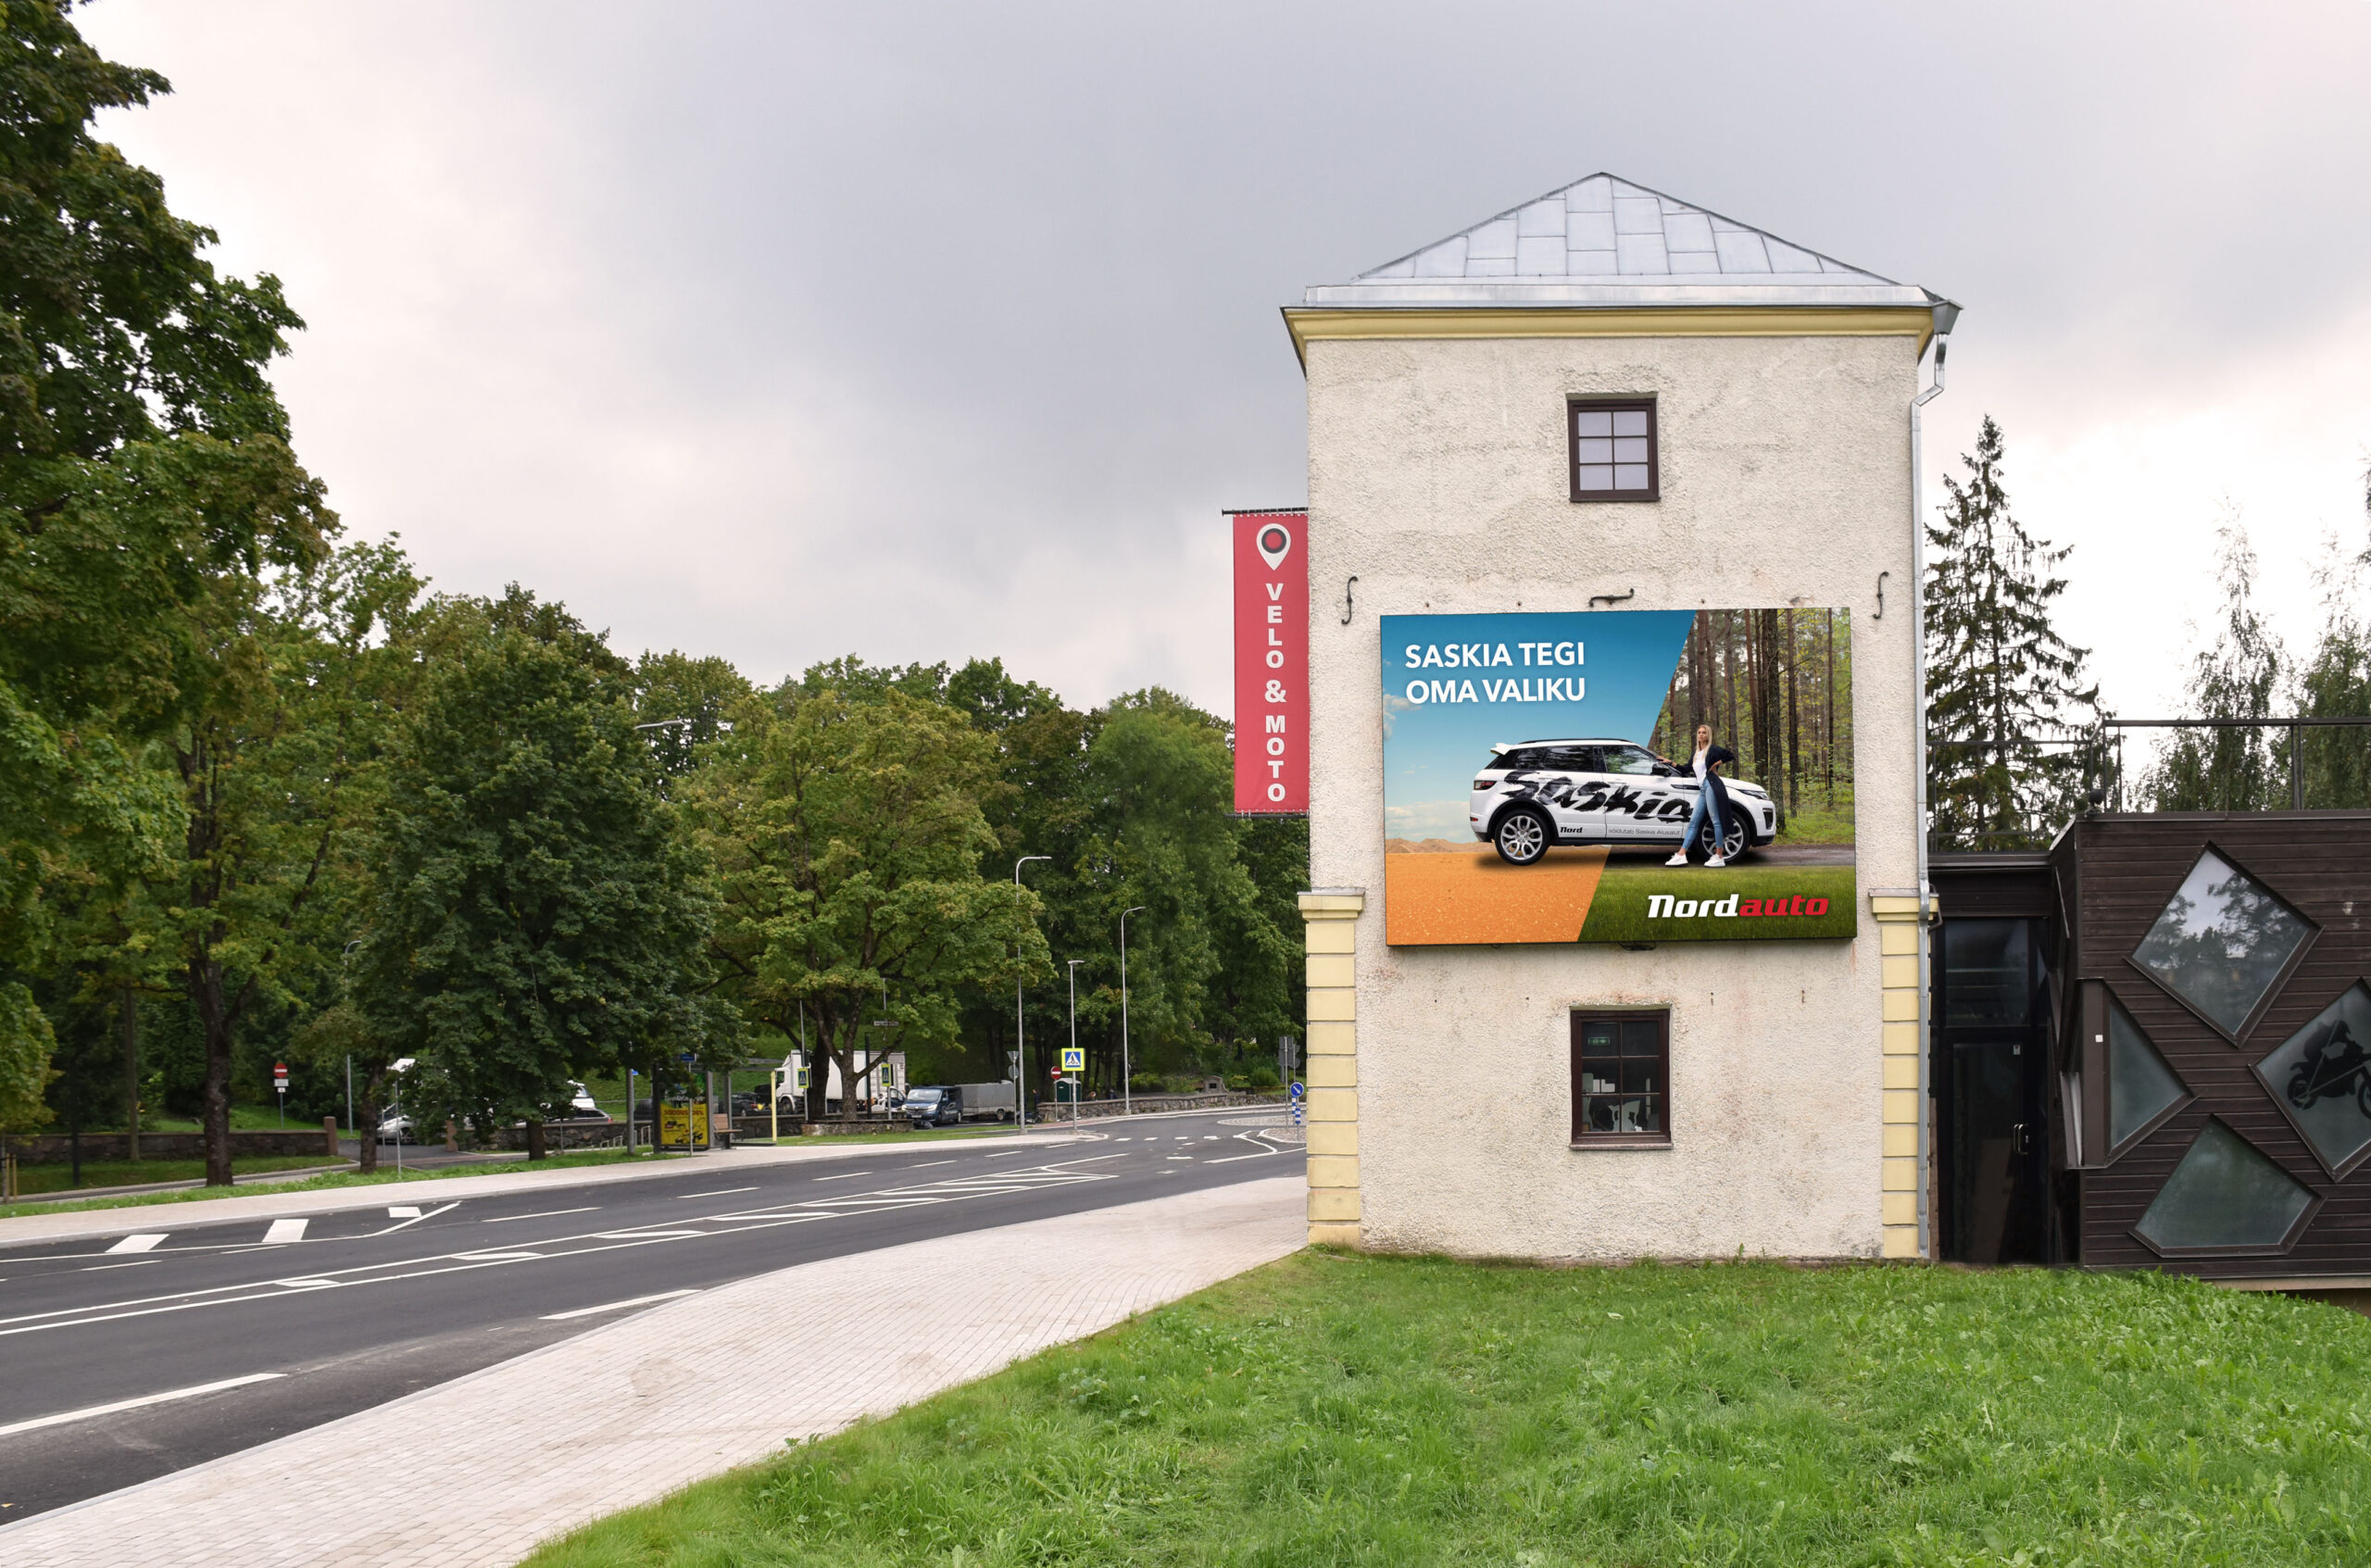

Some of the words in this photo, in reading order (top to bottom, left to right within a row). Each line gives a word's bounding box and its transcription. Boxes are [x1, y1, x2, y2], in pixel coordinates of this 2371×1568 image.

[1265, 583, 1286, 669] VELO
[1405, 643, 1514, 669] SASKIA
[1518, 641, 1586, 667] TEGI
[1264, 679, 1287, 704] &
[1406, 679, 1480, 705] OMA
[1482, 677, 1586, 703] VALIKU
[1265, 714, 1286, 803] MOTO
[1500, 770, 1695, 824] Saskia
